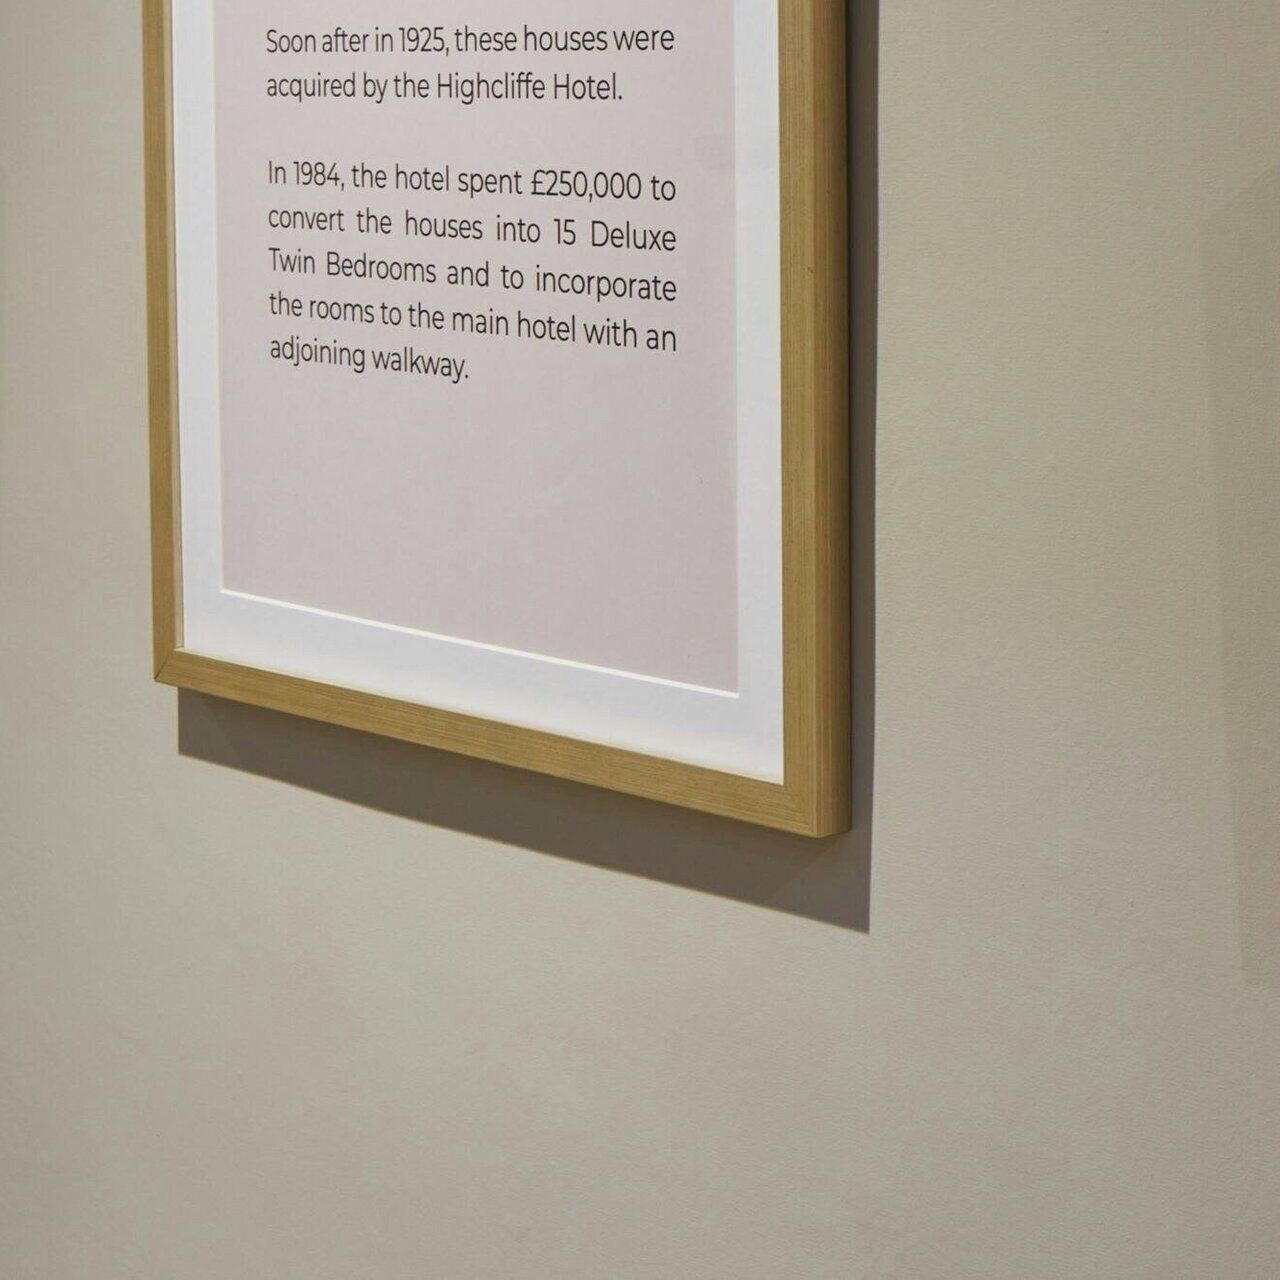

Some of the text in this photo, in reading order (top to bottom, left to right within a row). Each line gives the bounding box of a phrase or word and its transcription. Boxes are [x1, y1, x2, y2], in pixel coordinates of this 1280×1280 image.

[266, 23, 676, 57] Soon after in 1925, these houses were
[266, 71, 623, 106] acquired by the Highcliffe Hotel.
[268, 159, 677, 204] In 1984, the hotel spent £250,000 to
[268, 207, 677, 252] convert the houses into 15 Deluxe
[267, 246, 678, 304] Twin Bedrooms and to incorporate
[268, 289, 677, 353] the rooms to the main hotel with an
[269, 334, 469, 385] adjoining walkway.
